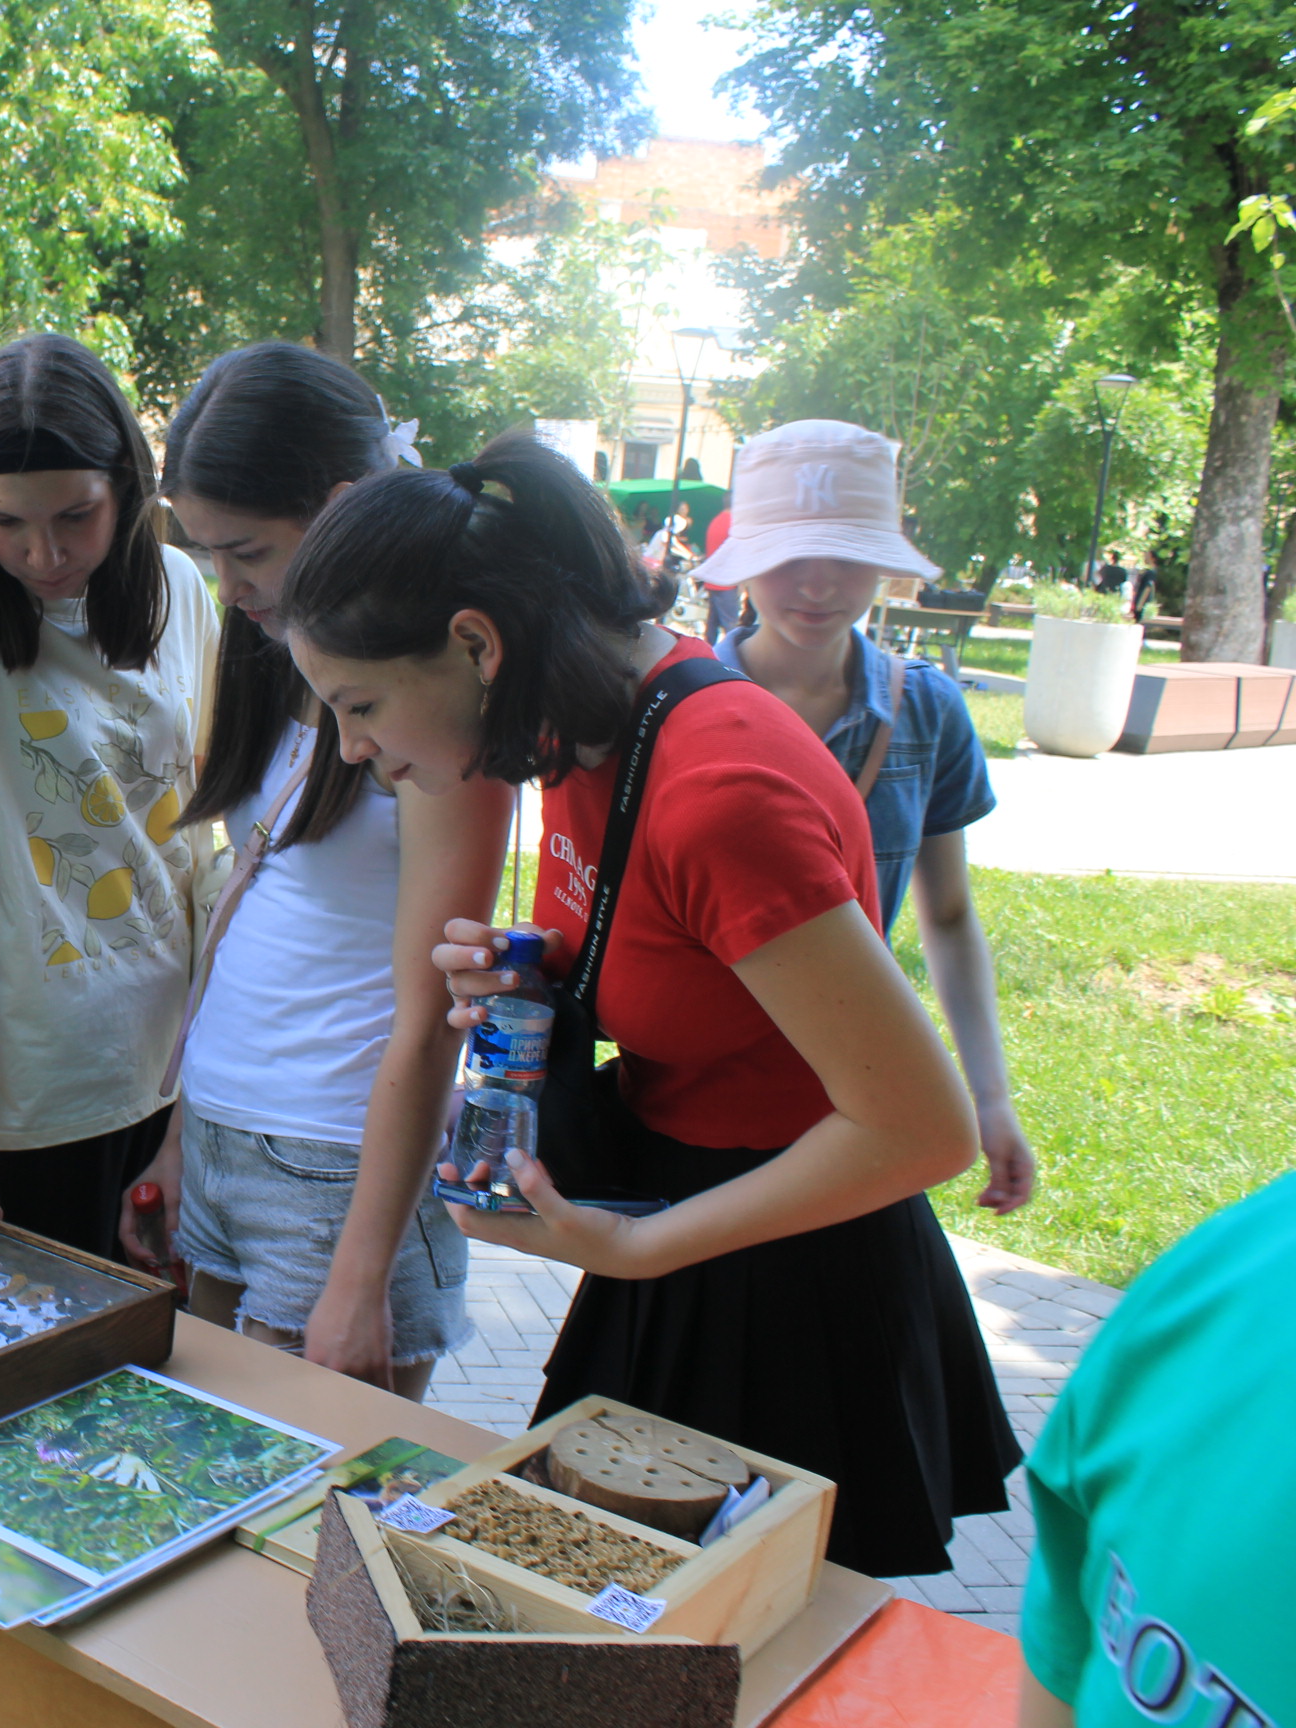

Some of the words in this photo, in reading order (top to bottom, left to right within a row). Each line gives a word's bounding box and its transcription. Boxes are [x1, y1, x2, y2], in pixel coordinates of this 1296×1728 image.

[620, 742, 642, 813] FASHION
[638, 690, 669, 738] STYLE
[44, 954, 117, 983] LEMON
[574, 933, 599, 1000] FASHION
[595, 884, 610, 931] STYLE
